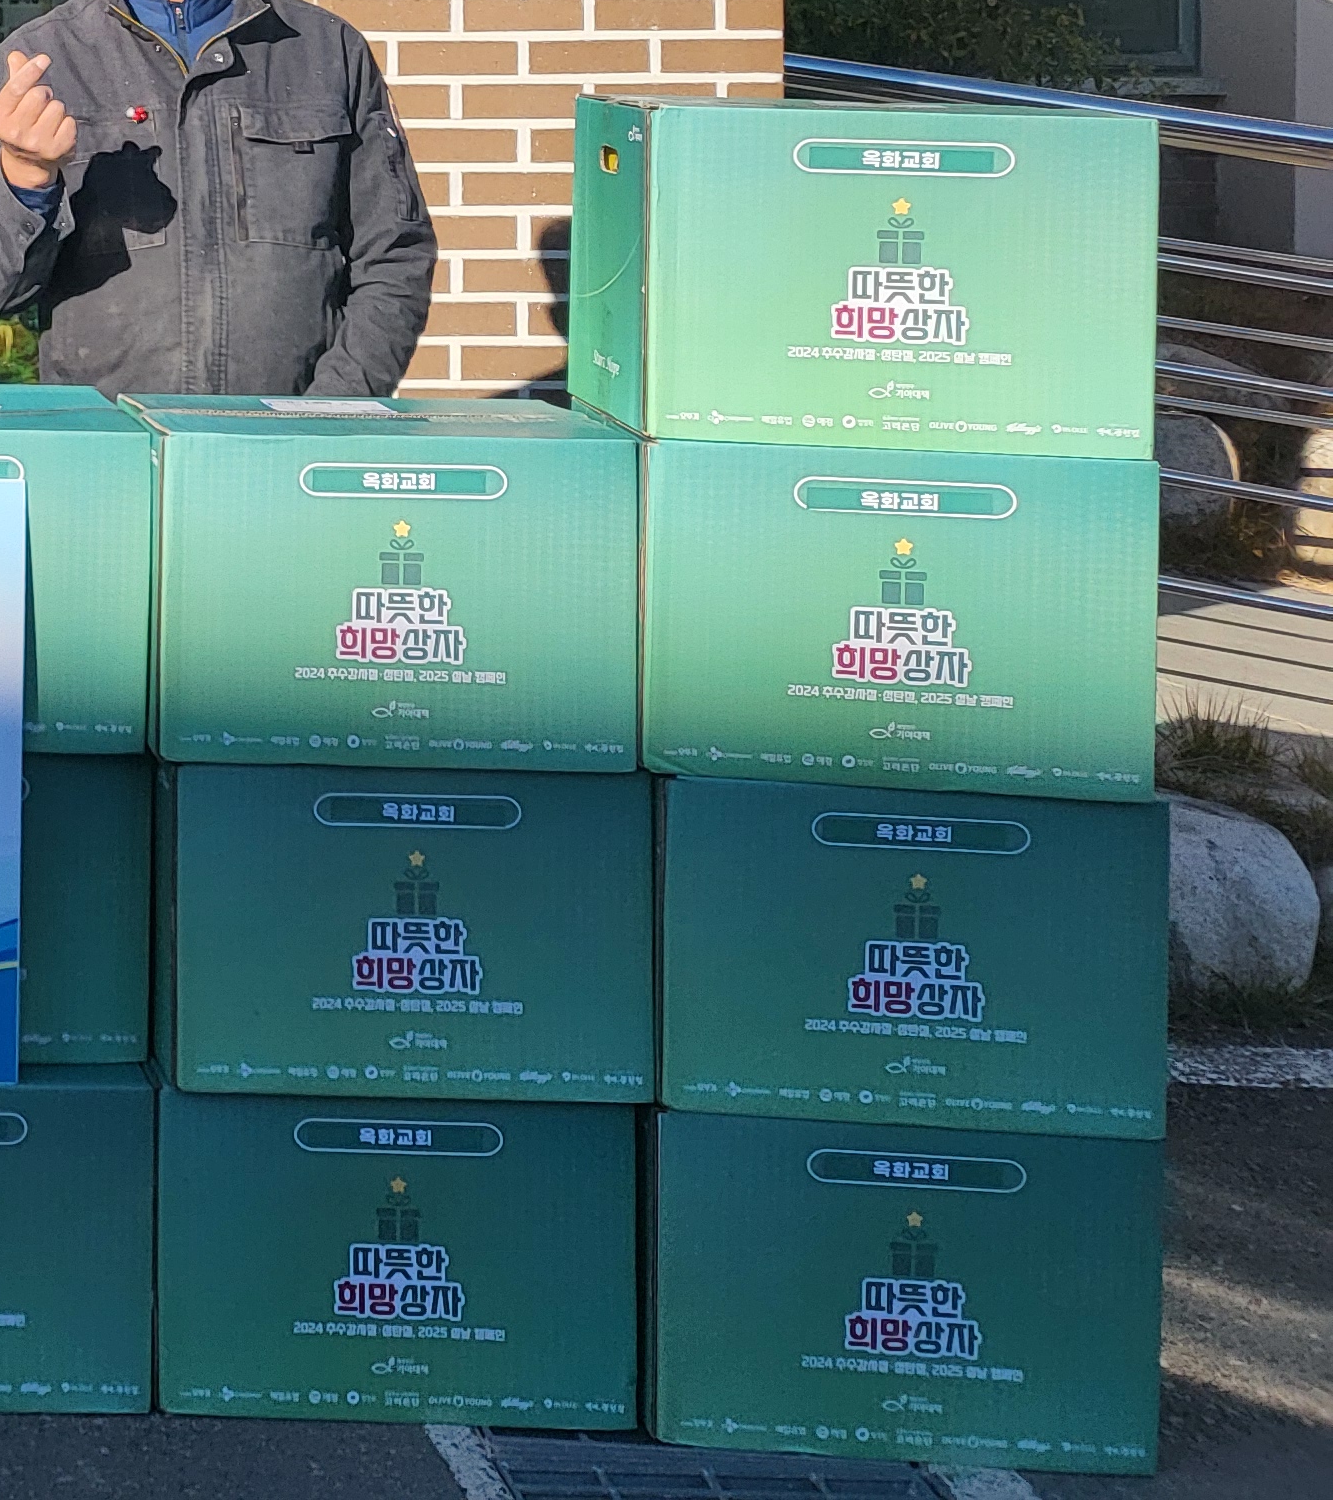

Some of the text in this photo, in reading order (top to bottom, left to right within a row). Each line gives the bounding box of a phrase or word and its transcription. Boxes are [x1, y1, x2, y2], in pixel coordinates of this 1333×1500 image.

[861, 148, 940, 170] 옥화교회
[851, 269, 951, 306] 따뜻한
[832, 304, 968, 343] 희망상자
[787, 346, 819, 359] 2024
[919, 350, 951, 363] 2025
[953, 351, 976, 364] 설날
[978, 351, 1013, 366] 캠페인
[929, 422, 955, 430] OLIVE
[967, 423, 998, 432] YOUNG
[362, 472, 435, 491] 옥화교회
[860, 490, 939, 512] 옥화교회
[355, 591, 450, 626] 따뜻한
[338, 625, 465, 661] 희망상자
[853, 610, 955, 647] 따뜻한
[294, 666, 325, 680] 2024
[418, 670, 449, 683] 2025
[834, 644, 970, 684] 희망상자
[787, 684, 820, 699] 2024
[920, 691, 952, 706] 2025
[382, 802, 455, 823] 옥화교회
[875, 822, 953, 844] 옥화교회
[371, 921, 465, 955] 따뜻한
[355, 956, 481, 992] 희망상자
[868, 944, 969, 980] 따뜻한
[851, 978, 984, 1019] 희망상자
[805, 1018, 837, 1033] 2024
[935, 1025, 967, 1040] 2025
[359, 1127, 432, 1148] 옥화교회
[872, 1159, 950, 1181] 옥화교회
[352, 1247, 447, 1281] 따뜻한
[337, 1281, 463, 1318] 희망상자
[865, 1282, 963, 1317] 따뜻한
[417, 1325, 448, 1340] 2025
[848, 1318, 980, 1357] 희망상자
